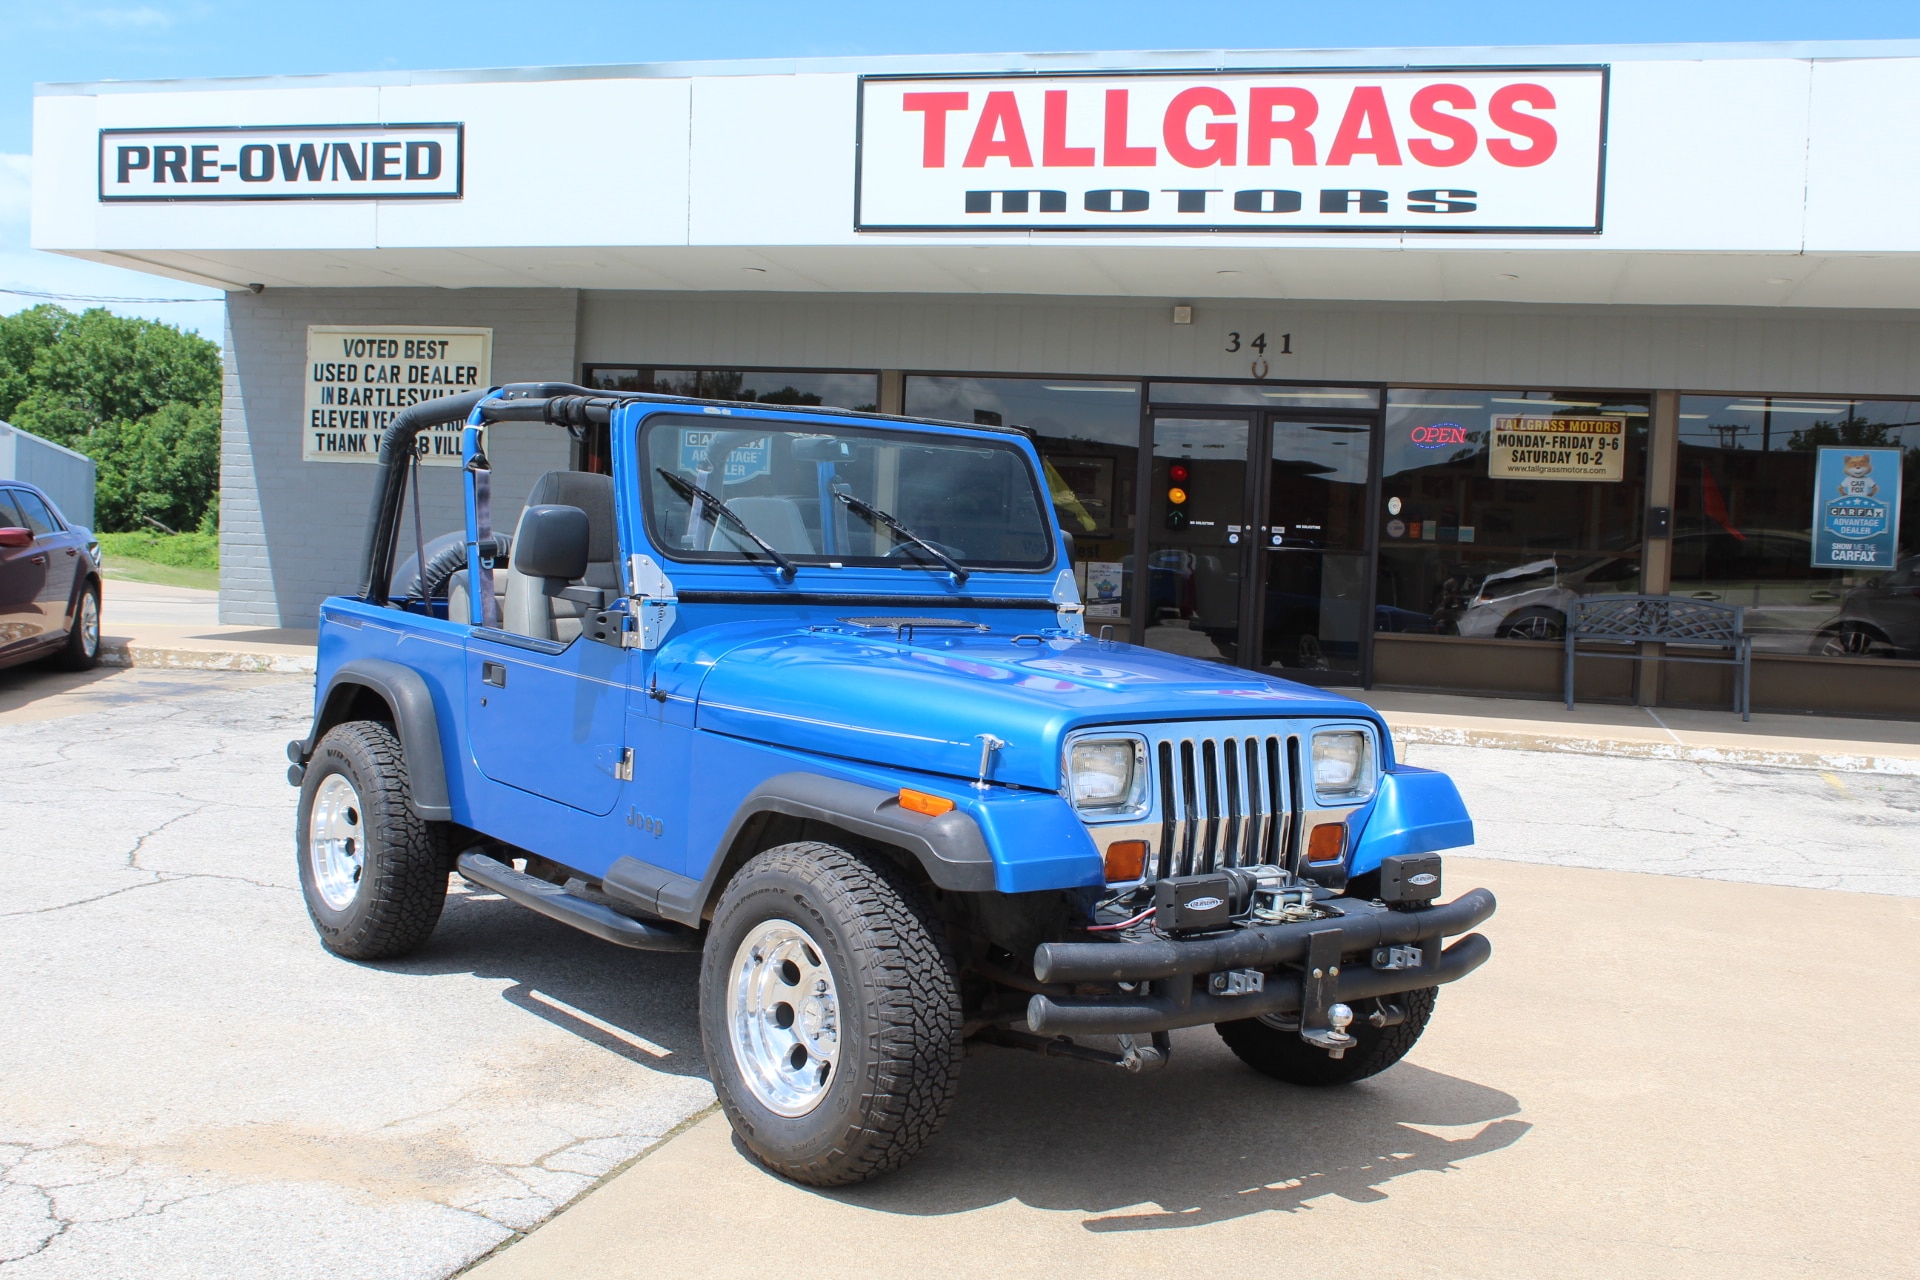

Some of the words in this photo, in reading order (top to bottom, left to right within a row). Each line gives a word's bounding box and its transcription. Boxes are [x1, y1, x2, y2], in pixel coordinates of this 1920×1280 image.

[902, 83, 1558, 168] TALLGRASS
[116, 141, 442, 184] PRE-OWNED
[965, 188, 1478, 214] MOTORS
[343, 338, 399, 359] VOTED
[404, 340, 448, 359] BEST
[1225, 332, 1293, 354] 341
[314, 363, 357, 382] USED
[364, 364, 400, 384] CAR
[408, 365, 477, 385] DEALER
[321, 386, 334, 405] IN
[338, 387, 471, 407] BARTLESV
[312, 409, 369, 429] ELEVEN
[1500, 420, 1565, 432] TALLGRASS
[1569, 421, 1619, 433] MOTORS
[315, 433, 366, 452] THANK
[434, 436, 463, 455] VILL
[1410, 426, 1466, 444] OPEN
[1497, 434, 1594, 449] MONDAY-FRIDAY
[1598, 437, 1619, 451] 9-6
[1511, 449, 1571, 464] SATURDAY
[1576, 451, 1603, 465] 10-2
[1507, 465, 1606, 474] www.tallgrassmotors.com
[1831, 508, 1882, 517] CARFAX
[1832, 550, 1876, 561] CARFAX
[1853, 543, 1863, 551] ME
[626, 803, 664, 839] Jeep
